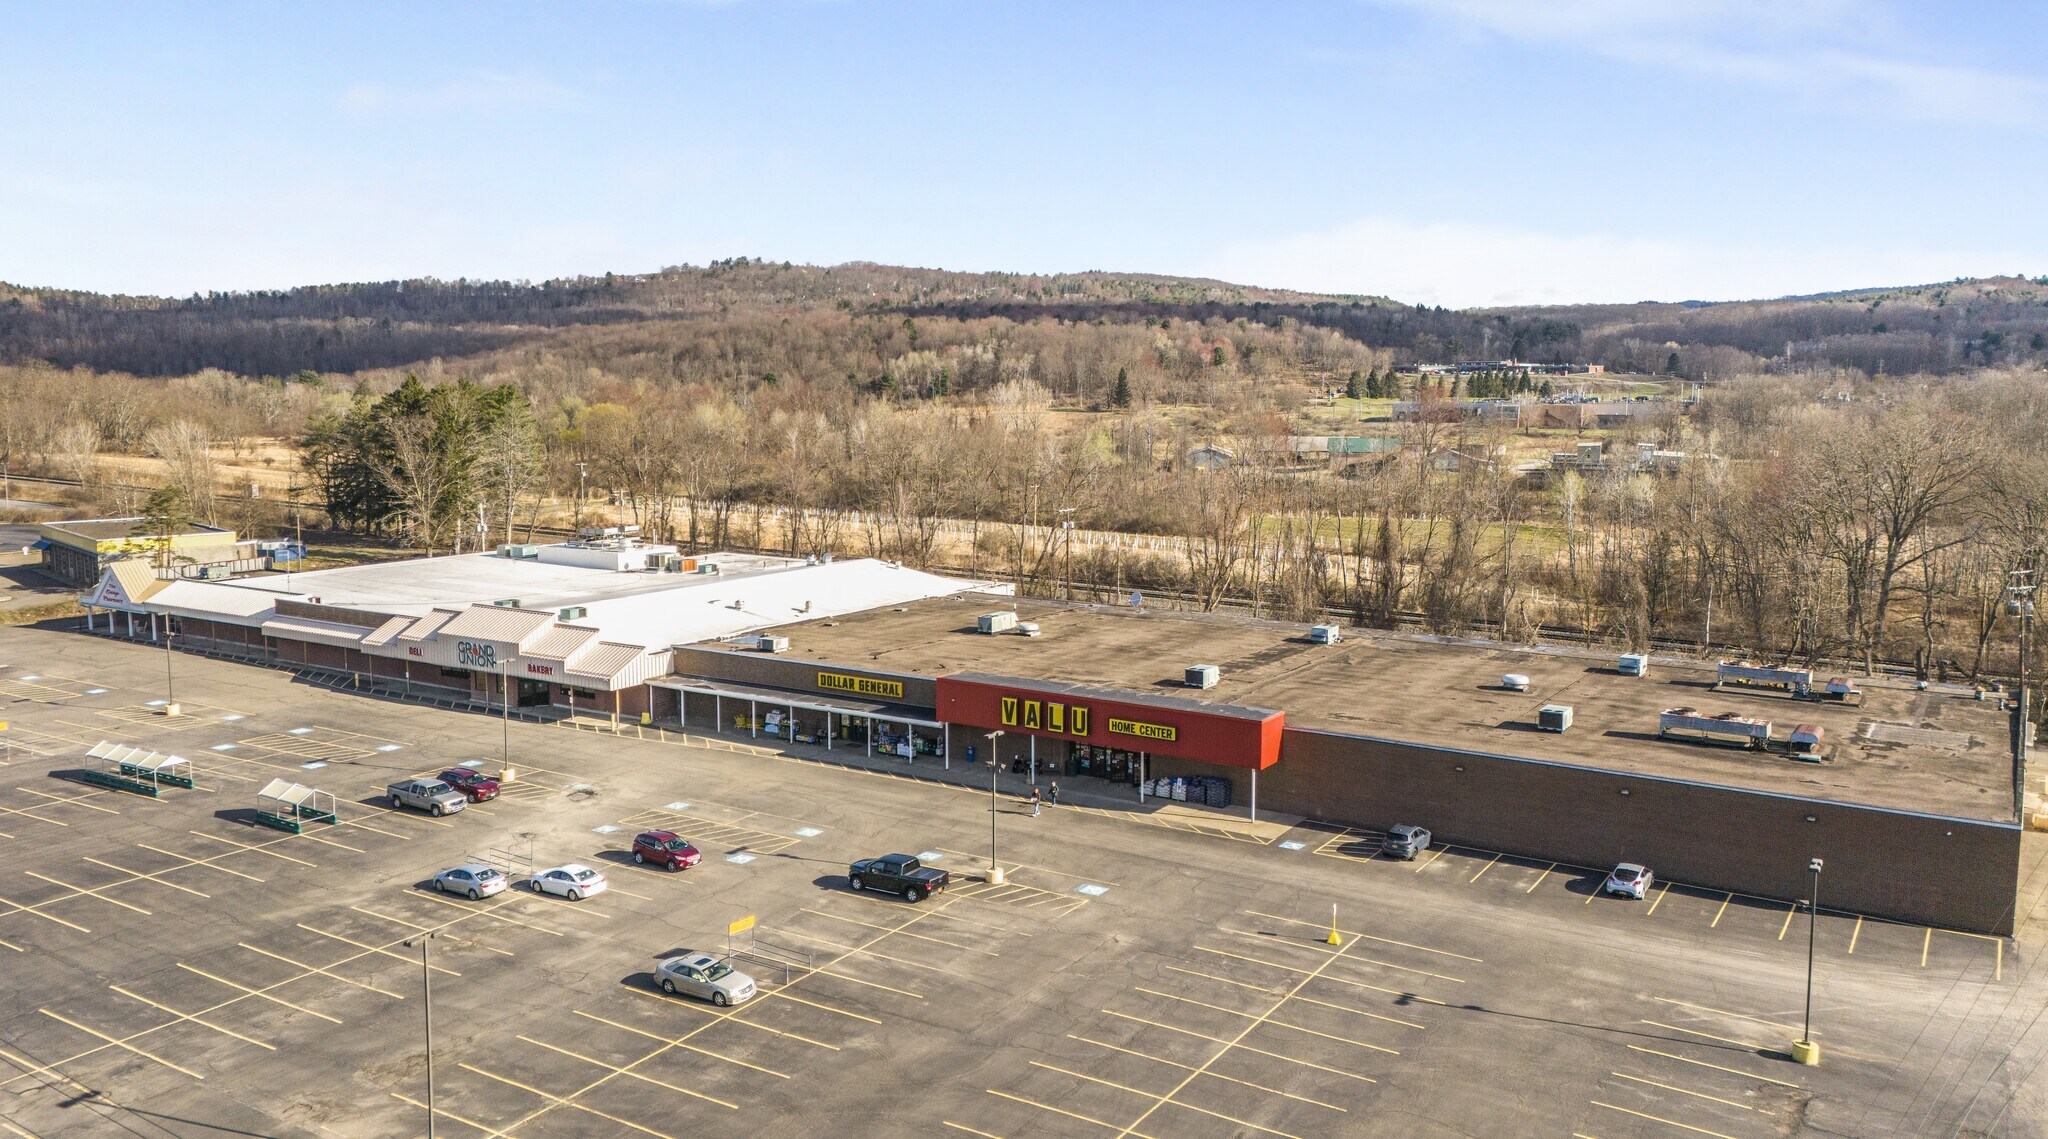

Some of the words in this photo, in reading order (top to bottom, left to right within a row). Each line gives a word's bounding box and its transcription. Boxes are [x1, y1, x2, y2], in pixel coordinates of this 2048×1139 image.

[409, 646, 423, 656] DELI
[458, 641, 496, 657] GRAND
[458, 653, 496, 668] UNION
[528, 664, 555, 676] BAKERY
[820, 674, 855, 690] DOLLAR
[858, 679, 900, 696] GENERAL
[1003, 700, 1086, 734] VALU
[1111, 720, 1136, 734] HOME
[1139, 726, 1173, 740] CENTER
